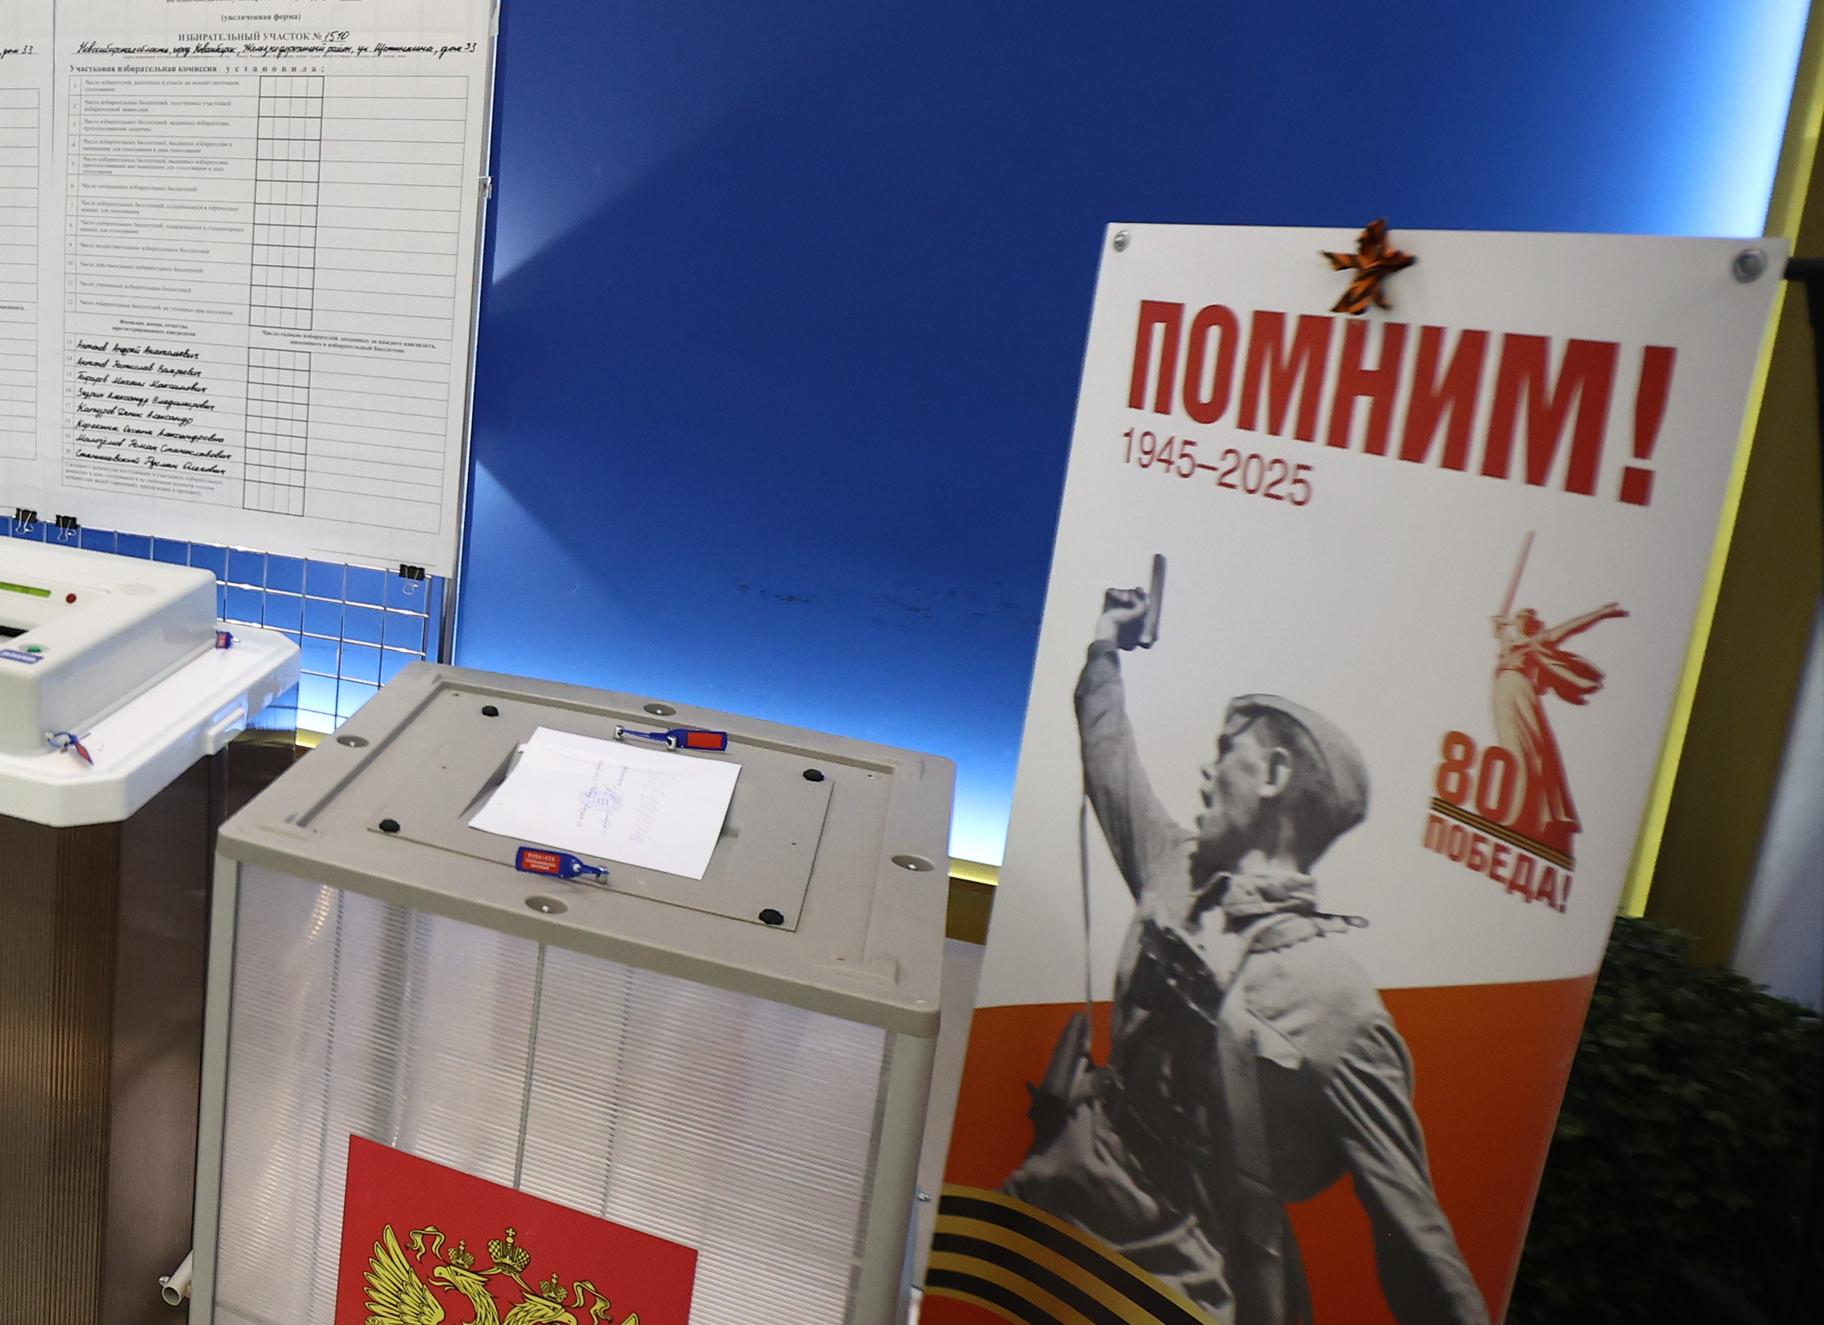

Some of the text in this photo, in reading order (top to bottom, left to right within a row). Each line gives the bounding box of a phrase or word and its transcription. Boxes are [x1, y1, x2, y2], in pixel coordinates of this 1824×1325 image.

[178, 32, 261, 42] ИЗБИРАТЕЛЬНЫЙ
[263, 32, 310, 41] УЧАСТОК
[313, 32, 322, 41] №
[274, 13, 301, 22] форма)
[70, 64, 115, 73] Участковая
[118, 64, 176, 73] избирательная
[178, 65, 217, 73] комиссия
[1127, 299, 1677, 507] ПОМНИМ!
[1436, 730, 1519, 823] 80
[1423, 813, 1573, 914] ПОБЕДА!
